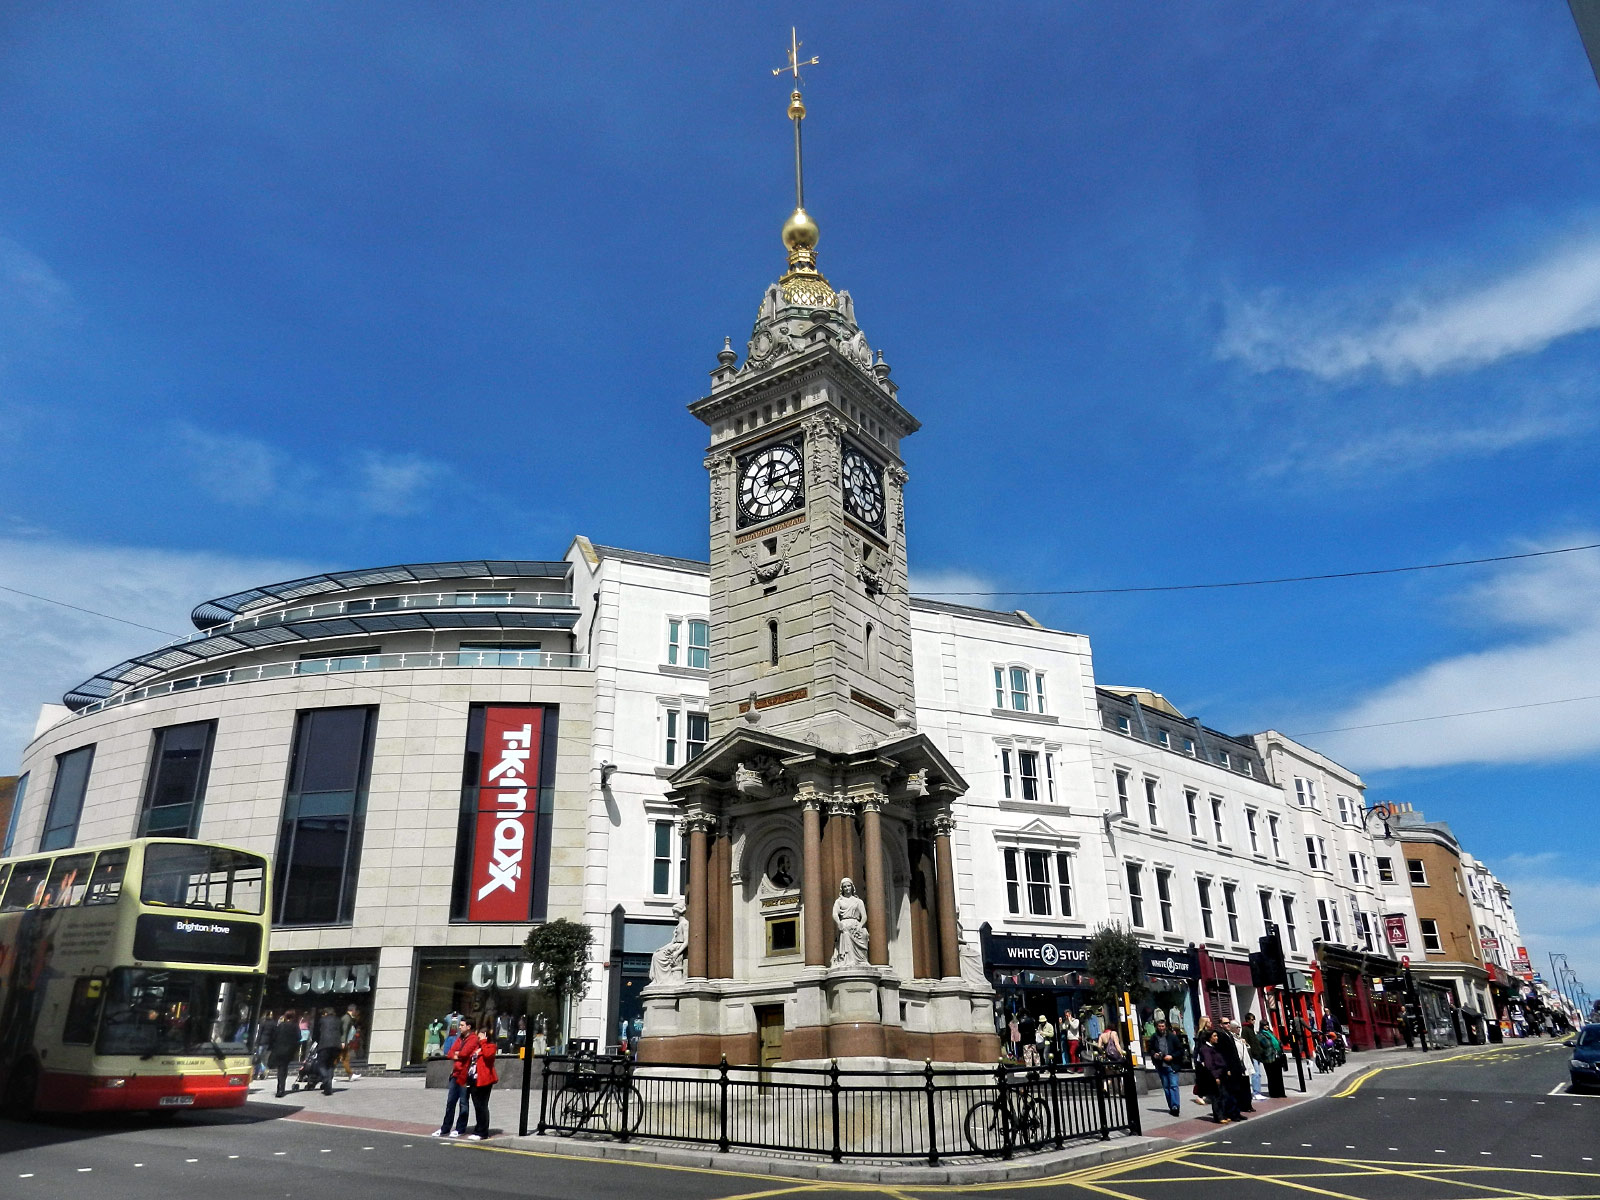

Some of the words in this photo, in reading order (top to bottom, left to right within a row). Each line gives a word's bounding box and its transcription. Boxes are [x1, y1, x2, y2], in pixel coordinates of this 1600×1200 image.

[176, 921, 209, 932] Brighton
[210, 924, 230, 934] Hove
[1007, 947, 1041, 959] WHITE
[1059, 949, 1091, 961] STUFF
[1151, 959, 1167, 968] WHITE
[1175, 962, 1189, 971] STUFF
[288, 964, 374, 994] CULT
